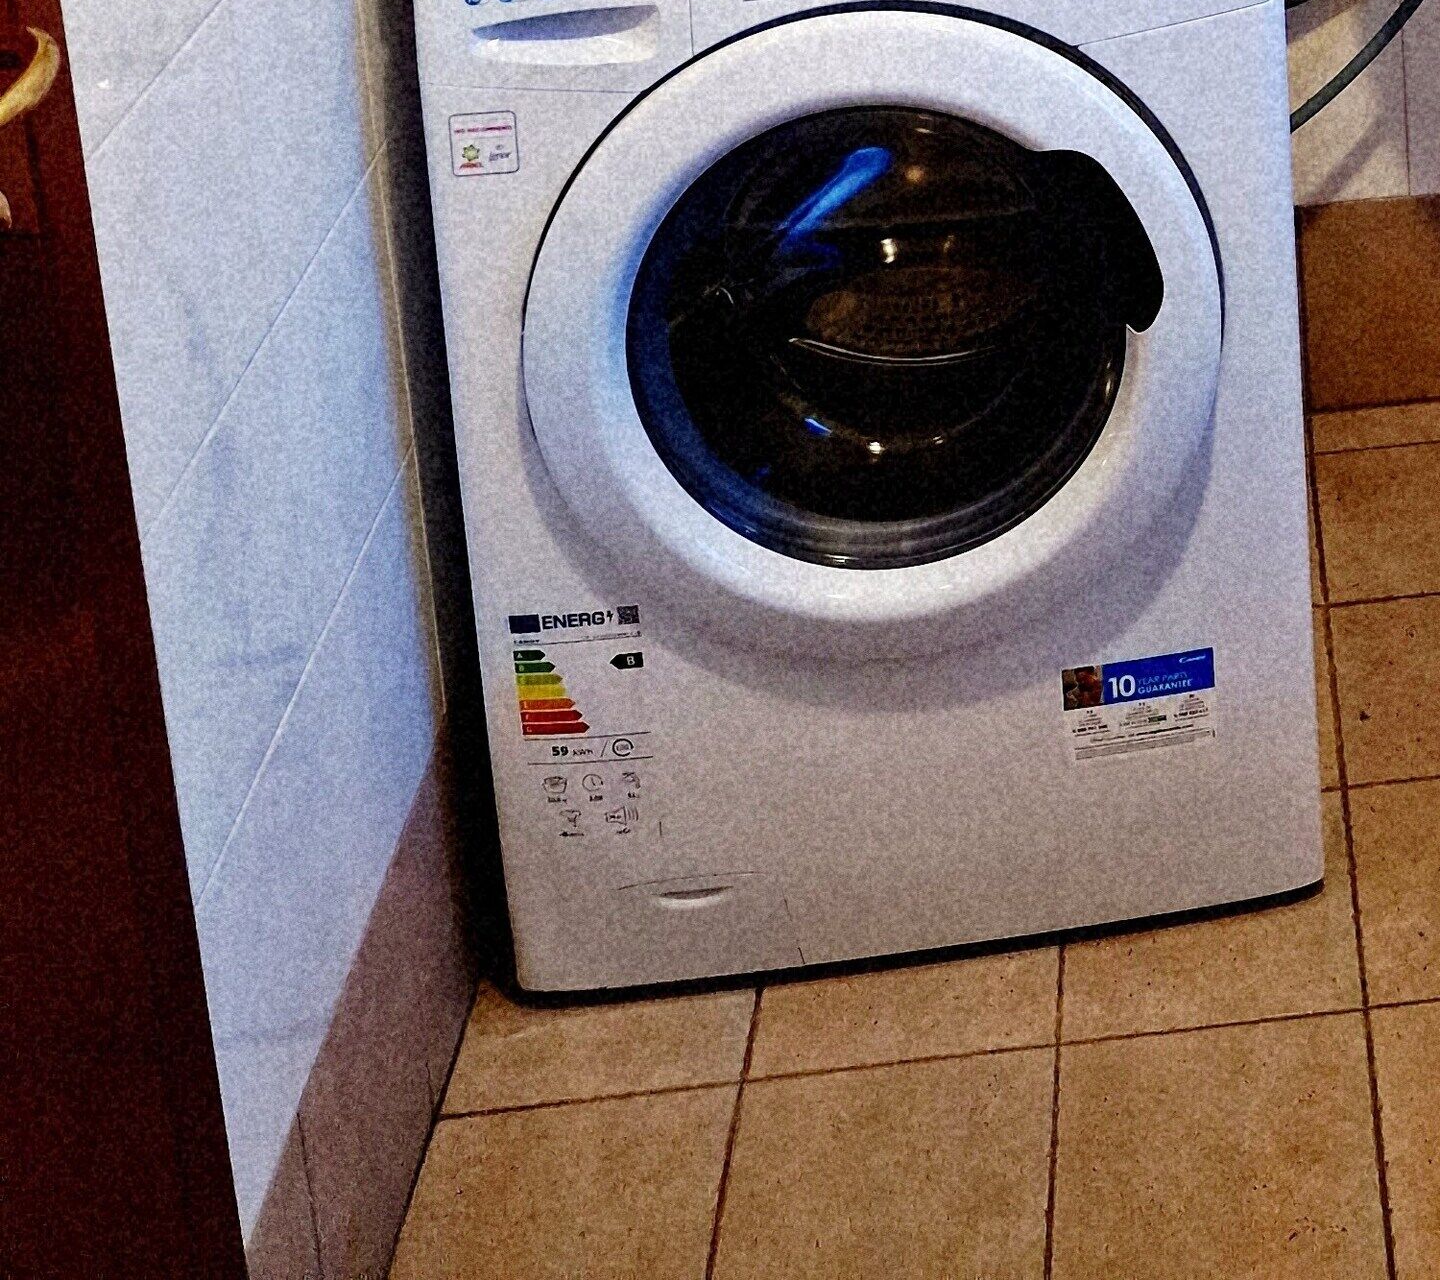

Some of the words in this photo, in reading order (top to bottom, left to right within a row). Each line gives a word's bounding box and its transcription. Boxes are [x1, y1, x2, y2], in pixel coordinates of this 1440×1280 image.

[541, 612, 605, 631] ENERG
[626, 655, 636, 666] B
[1107, 673, 1137, 700] 10
[1136, 678, 1193, 695] GUARANTEE
[551, 745, 569, 757] 59
